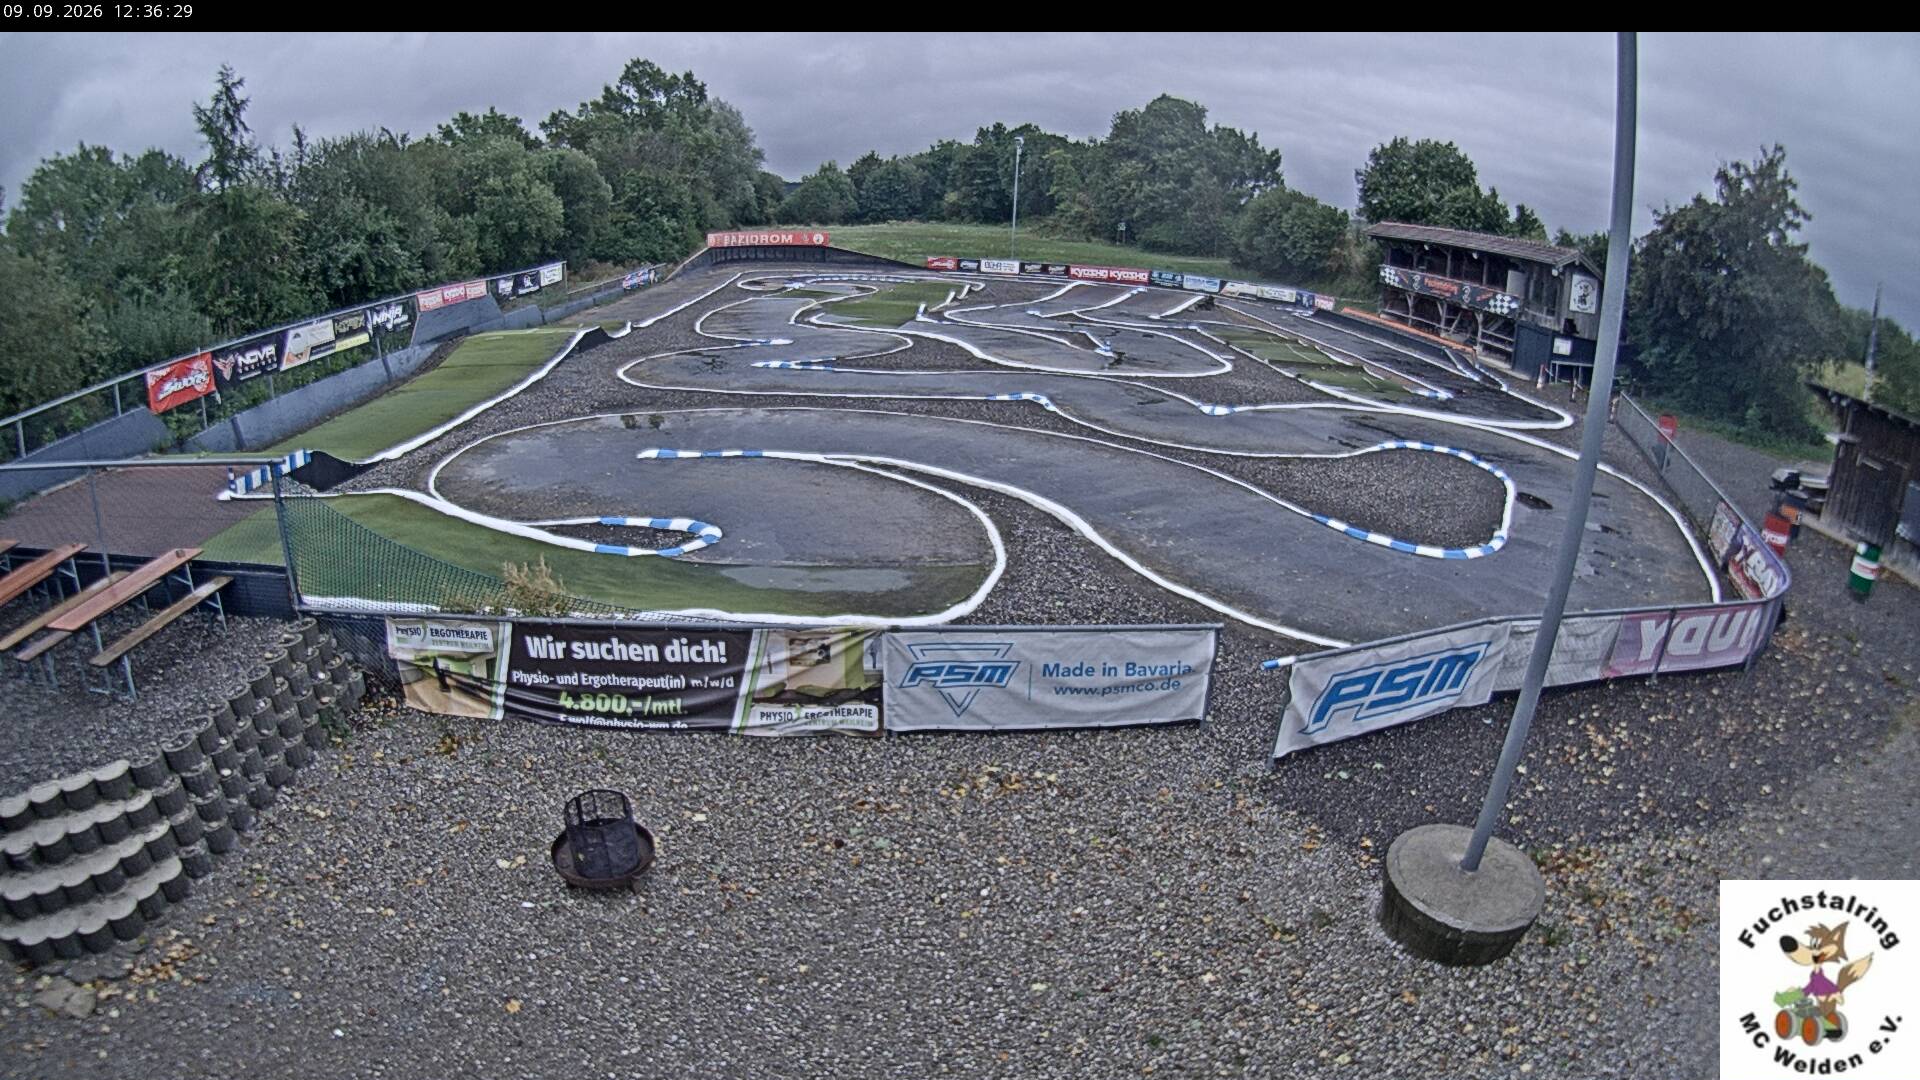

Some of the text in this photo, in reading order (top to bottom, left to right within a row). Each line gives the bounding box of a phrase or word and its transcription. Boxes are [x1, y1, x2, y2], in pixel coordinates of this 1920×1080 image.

[1070, 267, 1108, 279] KYOSHO
[1110, 269, 1148, 281] KYOSHO
[236, 344, 278, 366] NOVA
[430, 628, 488, 641] ERGOTHERAPIE
[525, 635, 728, 664] Wir suchen dich!
[905, 662, 1014, 685] PSM
[1042, 660, 1193, 677] Made in Bavaria
[511, 669, 735, 691] Physio- und Ergotherapeut(in) m/w/d
[1054, 678, 1181, 697] www.psmco.de
[1312, 651, 1481, 725] PSM
[759, 711, 793, 721] PHYSIO
